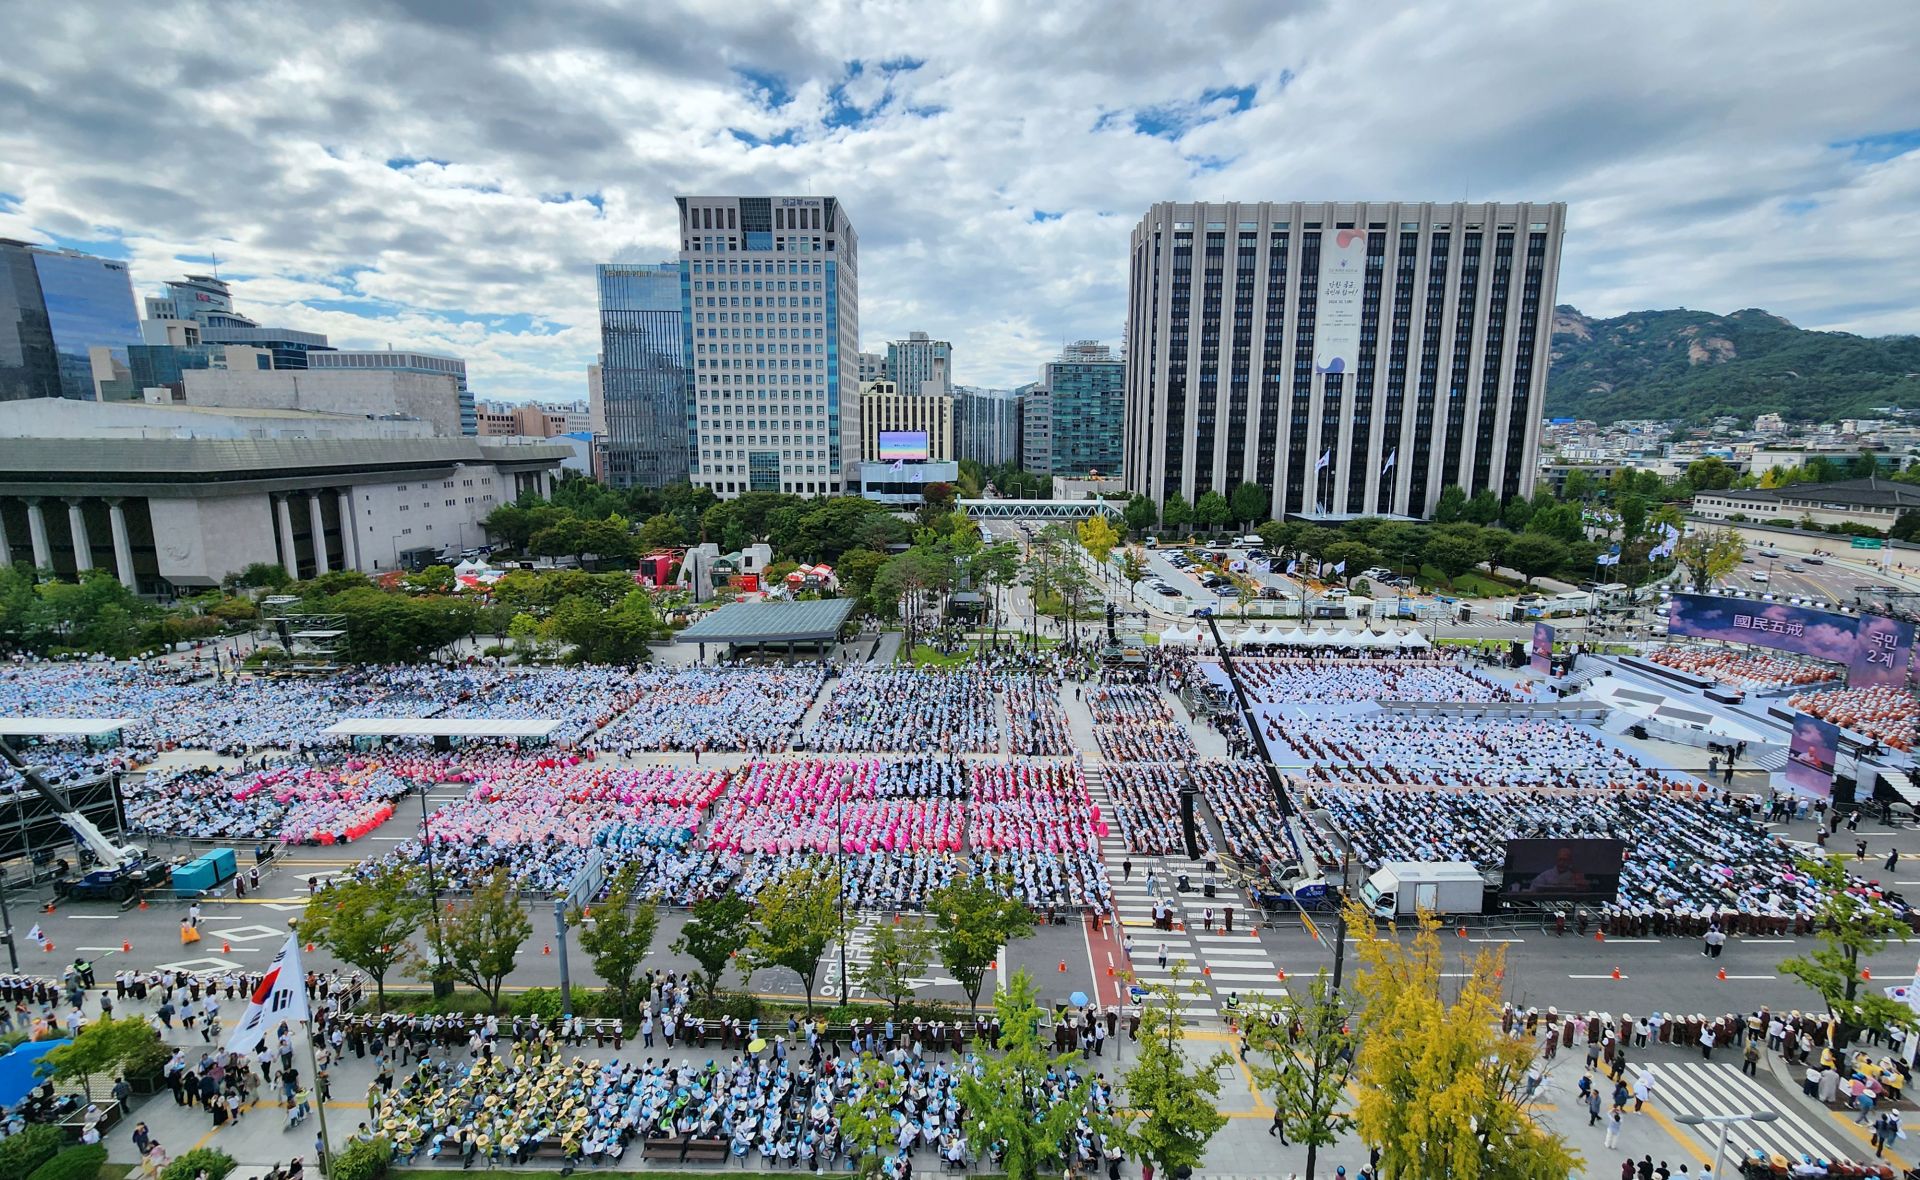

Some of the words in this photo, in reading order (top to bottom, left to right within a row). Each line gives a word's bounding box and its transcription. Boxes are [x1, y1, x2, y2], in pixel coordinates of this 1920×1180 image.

[1733, 614, 1803, 637] 國民五戒
[1871, 631, 1898, 650] 국민
